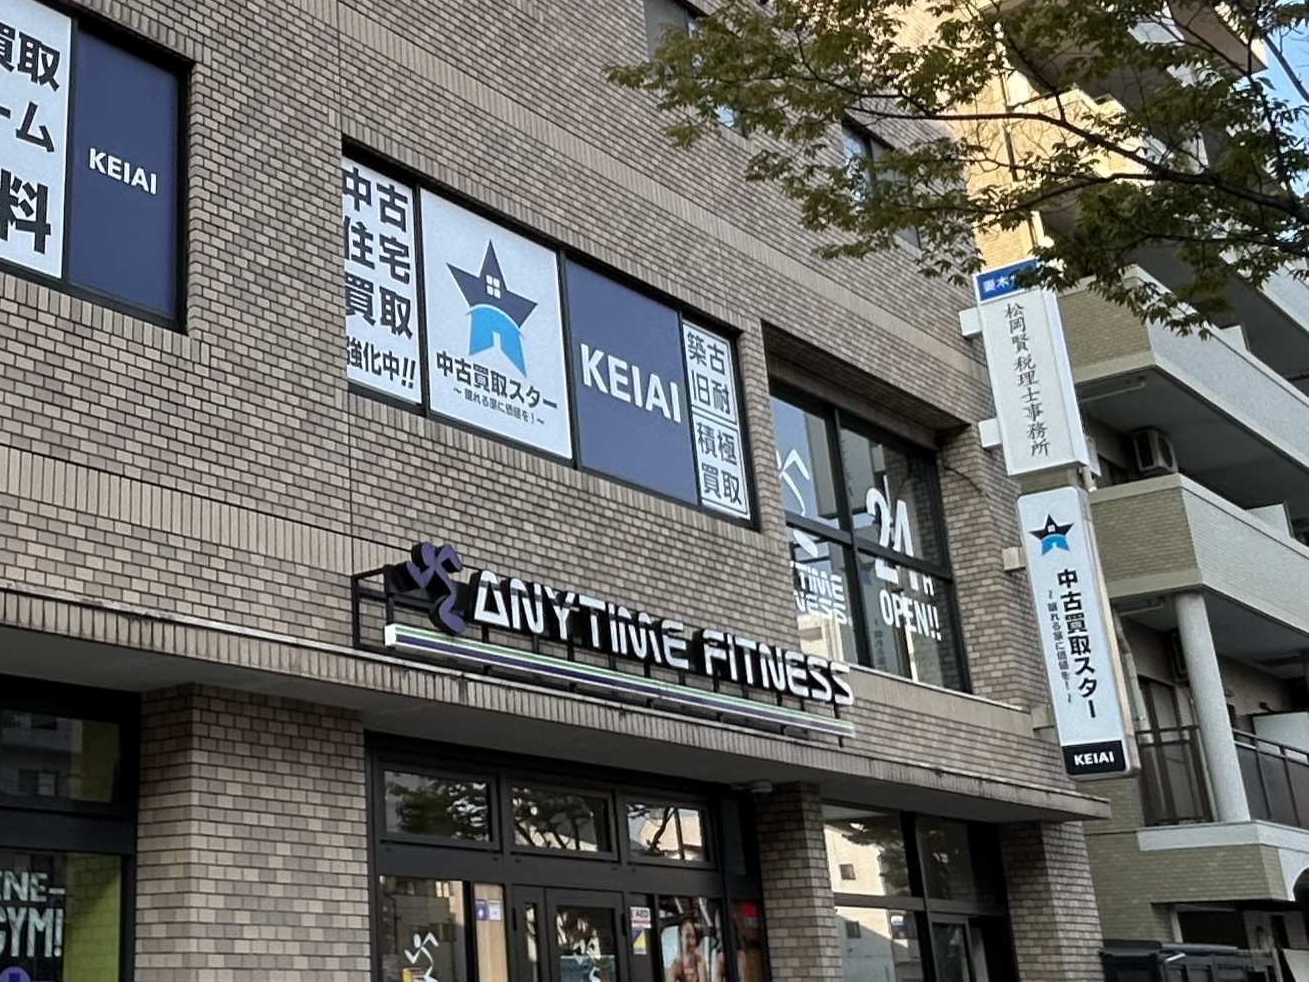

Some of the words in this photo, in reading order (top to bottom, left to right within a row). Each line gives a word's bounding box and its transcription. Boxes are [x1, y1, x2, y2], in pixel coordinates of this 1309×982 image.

[88, 147, 158, 196] KEIAI
[435, 350, 558, 410] 中古買取スター
[579, 342, 683, 424] KEIAI
[701, 461, 743, 506] 買取
[473, 568, 690, 671] ANYTIME
[704, 627, 855, 706] FITNESS
[1056, 568, 1098, 718] 中古買取スター
[1073, 750, 1115, 766] KEIAI
